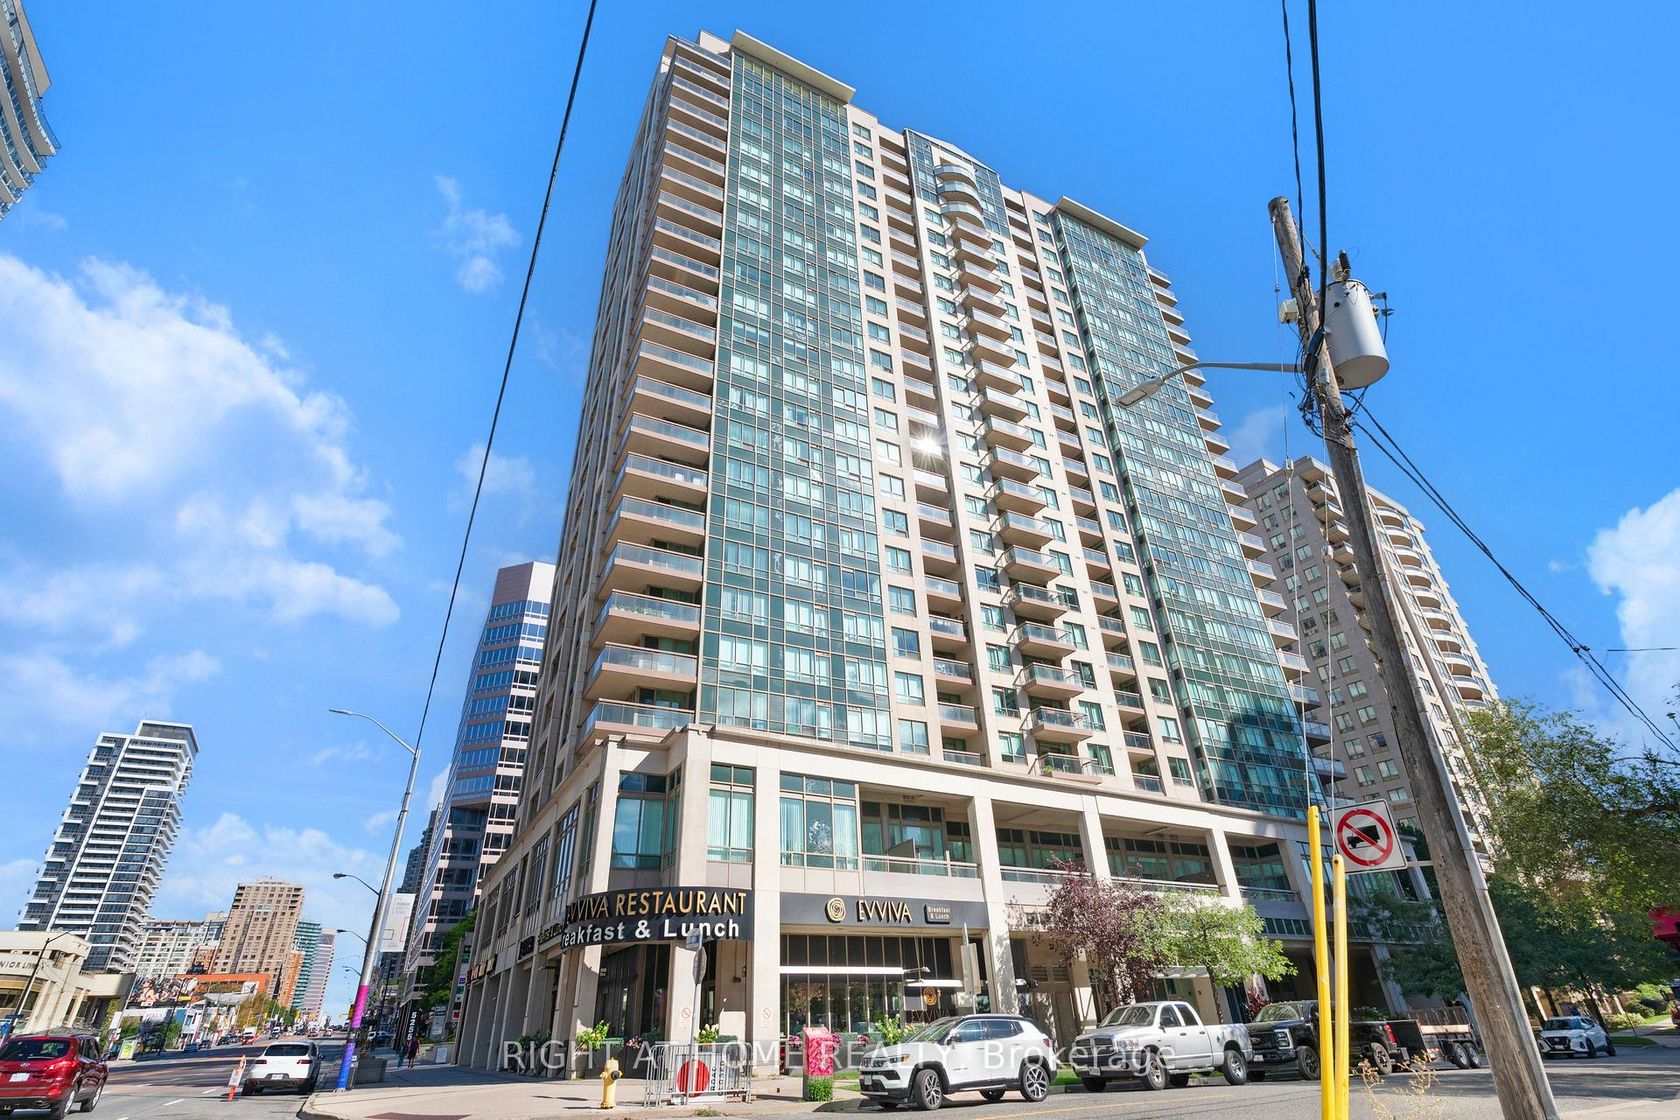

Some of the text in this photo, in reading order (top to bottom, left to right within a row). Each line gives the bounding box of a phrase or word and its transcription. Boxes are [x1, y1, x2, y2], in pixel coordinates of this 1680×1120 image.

[615, 891, 747, 916] RESTAURANT
[858, 900, 912, 921] EVVIVA
[562, 920, 625, 948] reakfast
[635, 919, 651, 939] &
[664, 919, 739, 938] Lunch
